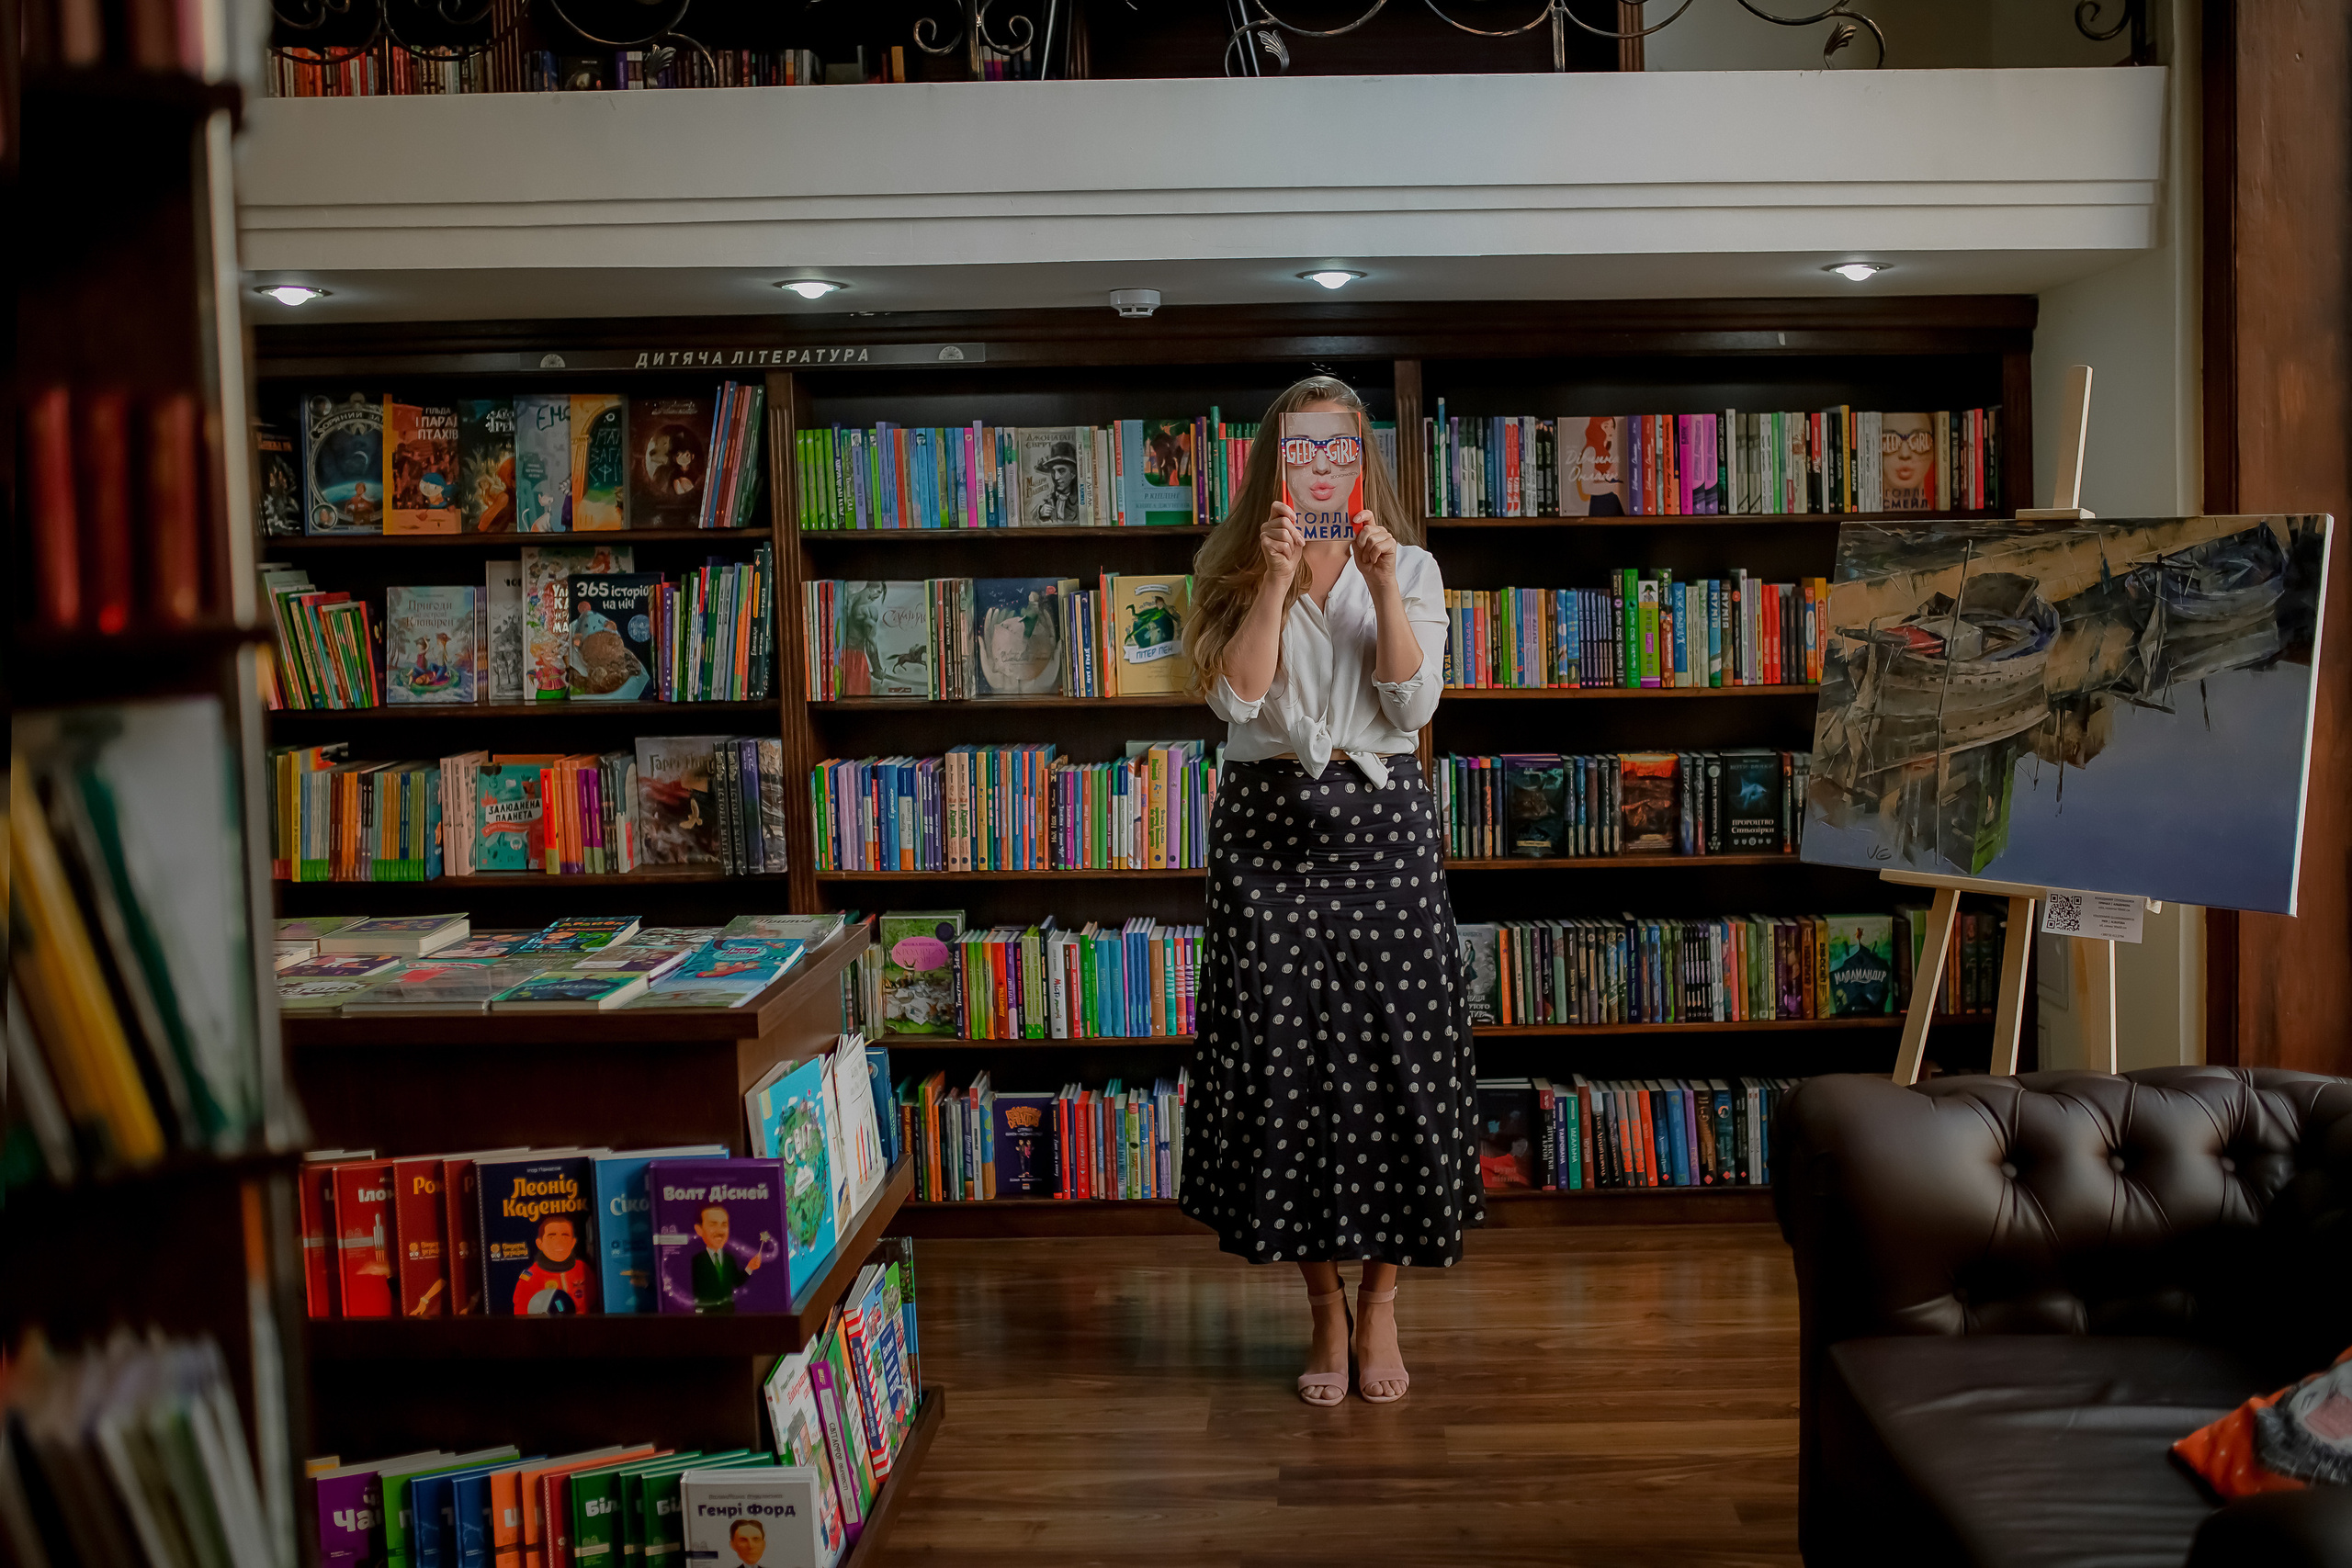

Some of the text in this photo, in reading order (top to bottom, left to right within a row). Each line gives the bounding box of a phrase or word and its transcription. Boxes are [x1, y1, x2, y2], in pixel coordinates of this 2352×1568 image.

[635, 347, 869, 368] ДИТЯЧА ЛІТЕРАТУРА
[417, 428, 459, 440] ПТАХІВ
[1295, 525, 1354, 539] МЕЙЛ
[576, 581, 650, 600] 365 історій
[408, 599, 452, 613] Пригоди
[603, 599, 635, 610] на ніч
[1136, 645, 1174, 660] ПІТЕР ПЕН
[488, 799, 540, 815] ЗАЛЮДНЕНА
[495, 810, 533, 822] ПЛАНЕТА
[1834, 967, 1888, 985] МАЛАМАНДЕР
[511, 1173, 579, 1200] Леонід
[662, 1183, 770, 1203] Волт Дісней
[503, 1197, 588, 1223] Каденюк
[697, 1502, 797, 1519] Генрі Форд
